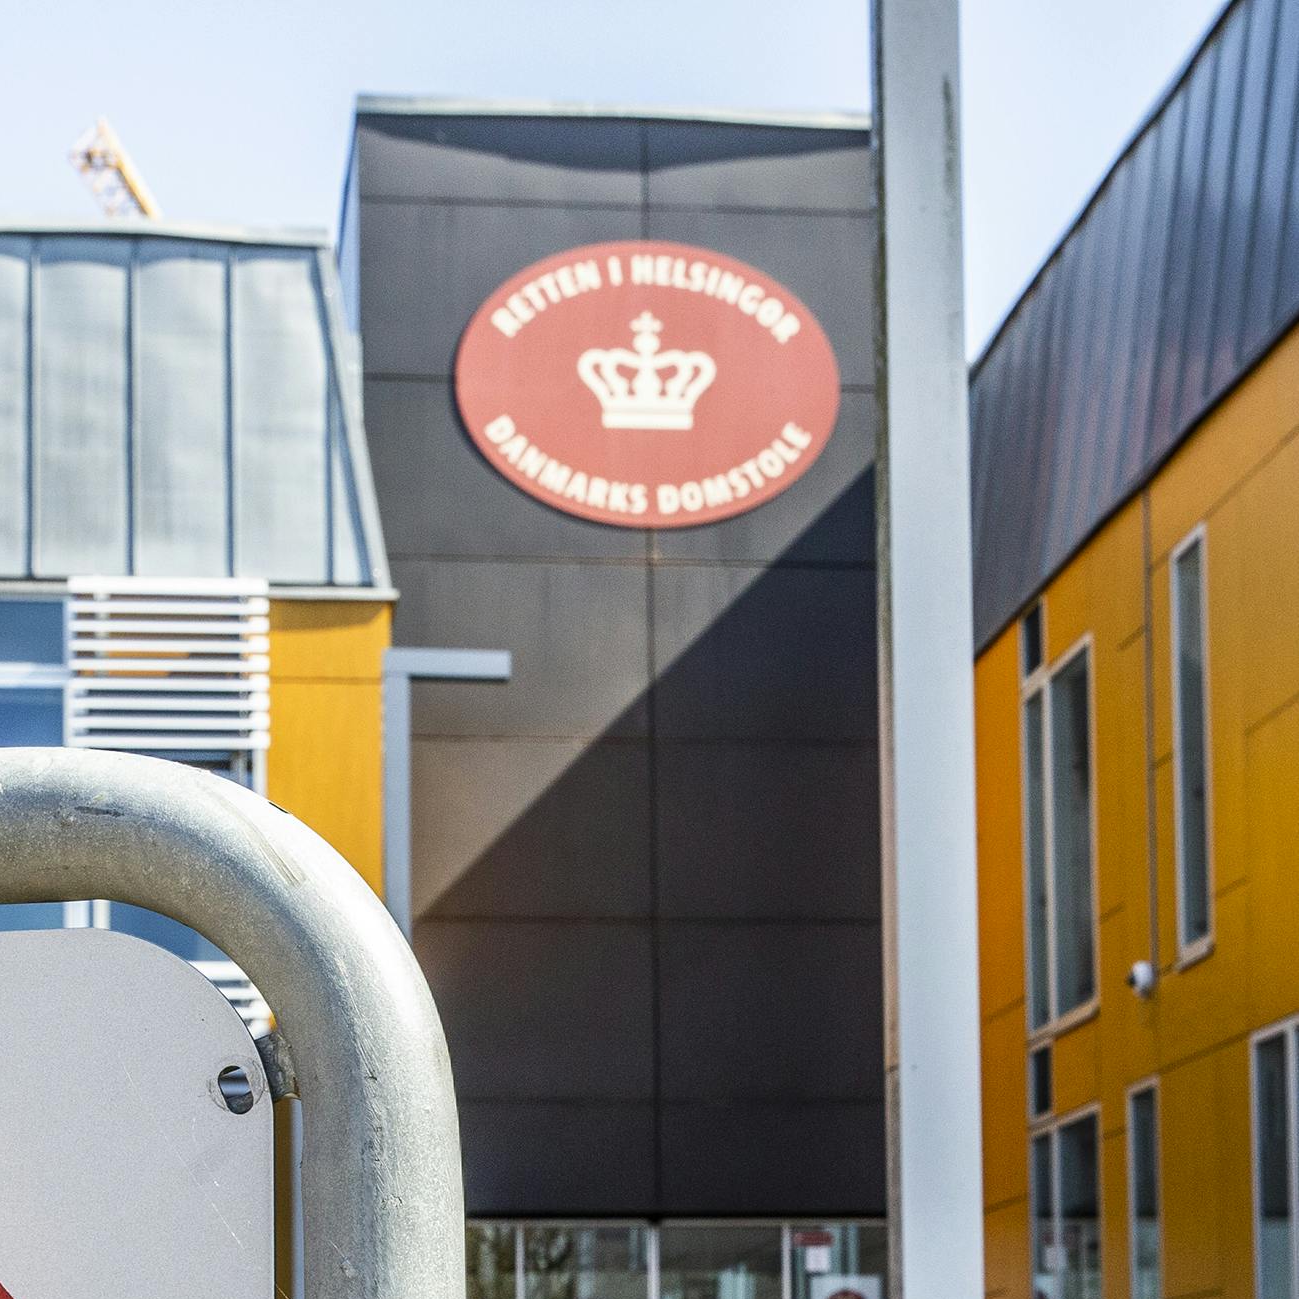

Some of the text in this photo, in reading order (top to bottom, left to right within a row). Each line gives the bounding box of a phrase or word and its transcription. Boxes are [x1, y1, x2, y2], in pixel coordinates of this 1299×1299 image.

[491, 259, 602, 338] RETTEN
[607, 255, 623, 287] I
[484, 415, 813, 515] DANMARKS DOMSTOLE
